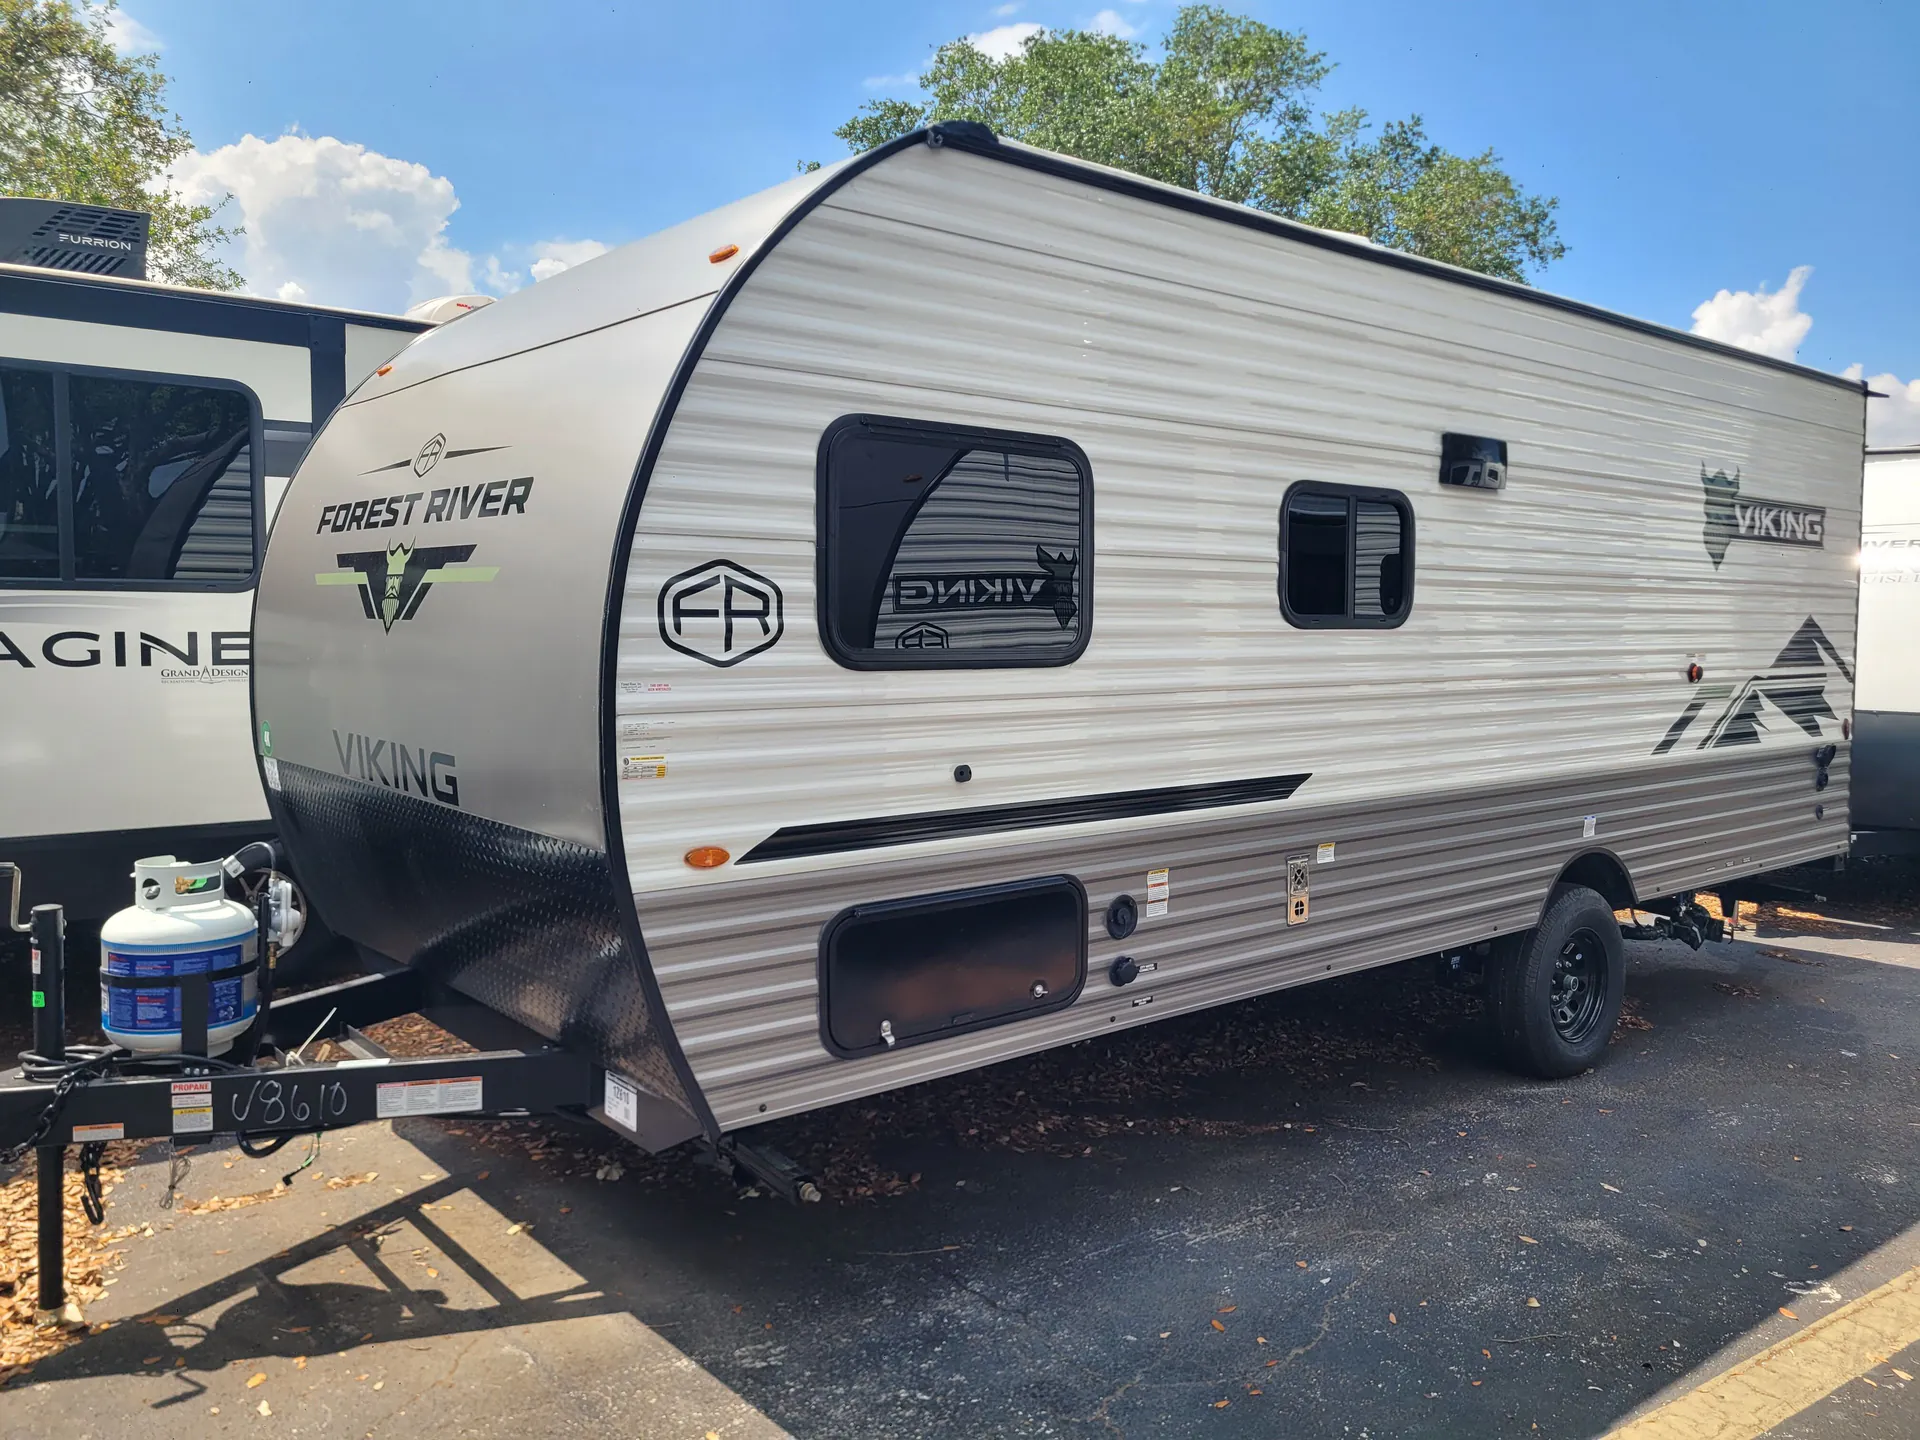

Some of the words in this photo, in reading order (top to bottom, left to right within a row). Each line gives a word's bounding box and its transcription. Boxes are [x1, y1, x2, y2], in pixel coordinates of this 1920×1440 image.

[59, 233, 131, 250] FURRION
[316, 491, 425, 535] FOREST
[422, 476, 535, 523] RIVER
[1734, 504, 1822, 541] VIKING
[161, 668, 200, 677] GRAND
[212, 668, 249, 677] DESIGN
[332, 728, 460, 807] VIKING
[172, 1082, 209, 1092] PROPANE
